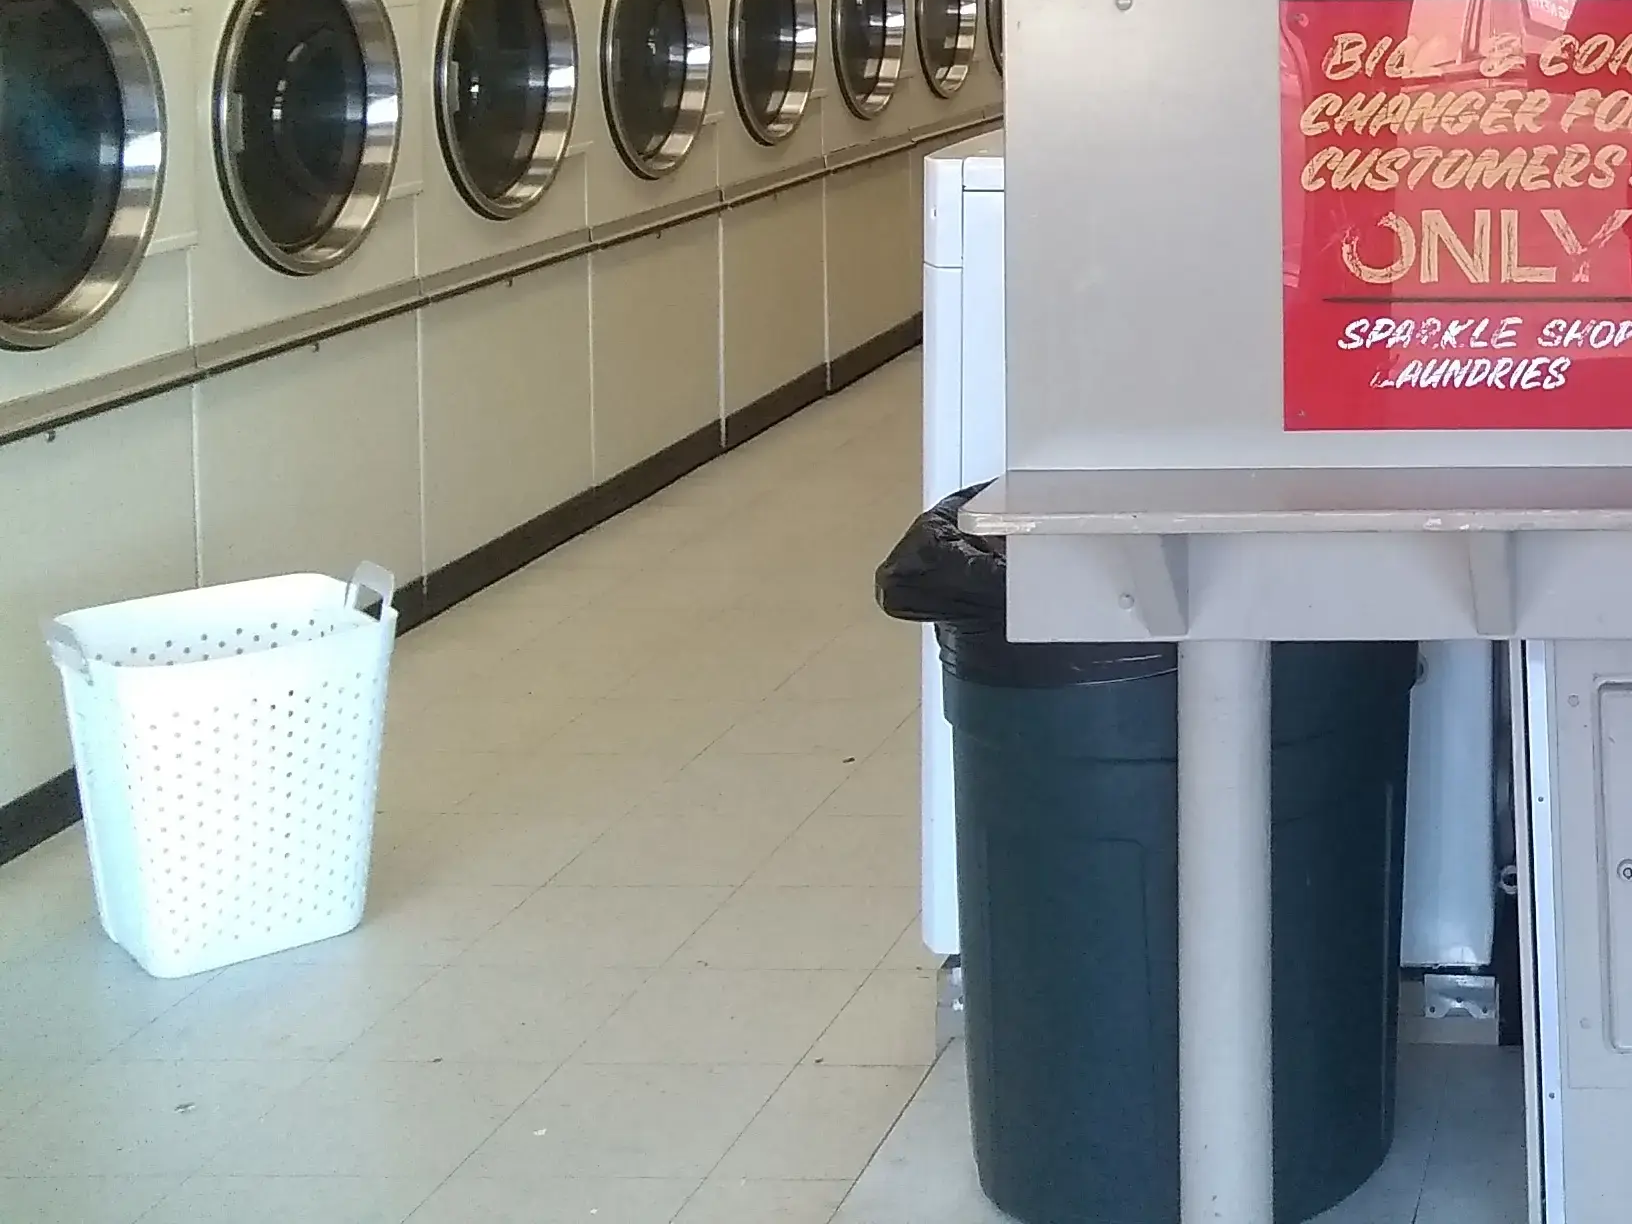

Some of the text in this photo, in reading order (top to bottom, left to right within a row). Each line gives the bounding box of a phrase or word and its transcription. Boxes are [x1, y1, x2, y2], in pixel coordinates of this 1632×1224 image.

[1323, 32, 1442, 80] BIL
[1300, 89, 1551, 136] CHANGER
[1337, 316, 1523, 351] SPARKLE
